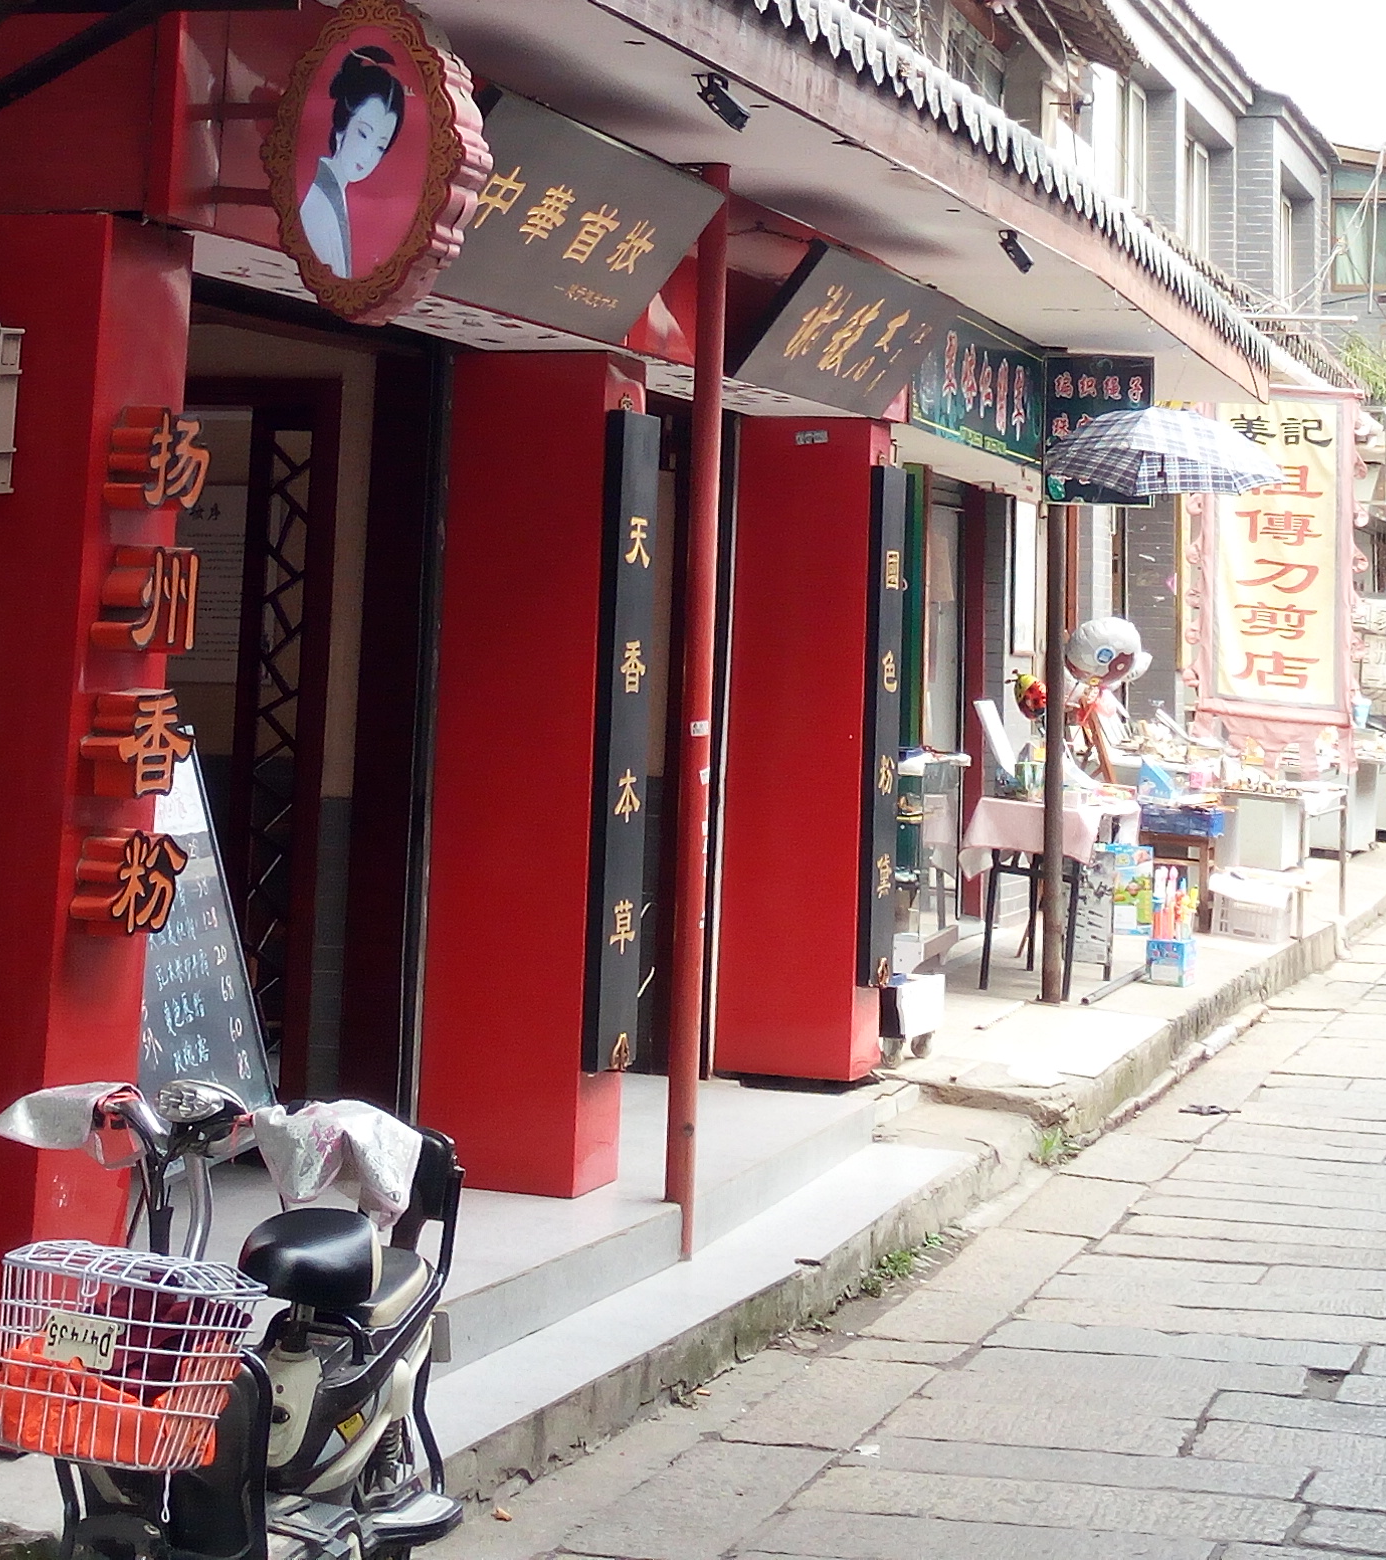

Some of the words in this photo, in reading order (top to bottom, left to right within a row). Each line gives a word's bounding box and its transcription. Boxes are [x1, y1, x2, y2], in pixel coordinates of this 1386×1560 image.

[112, 412, 211, 934] 扬州香粉
[609, 515, 651, 955] 天香本草
